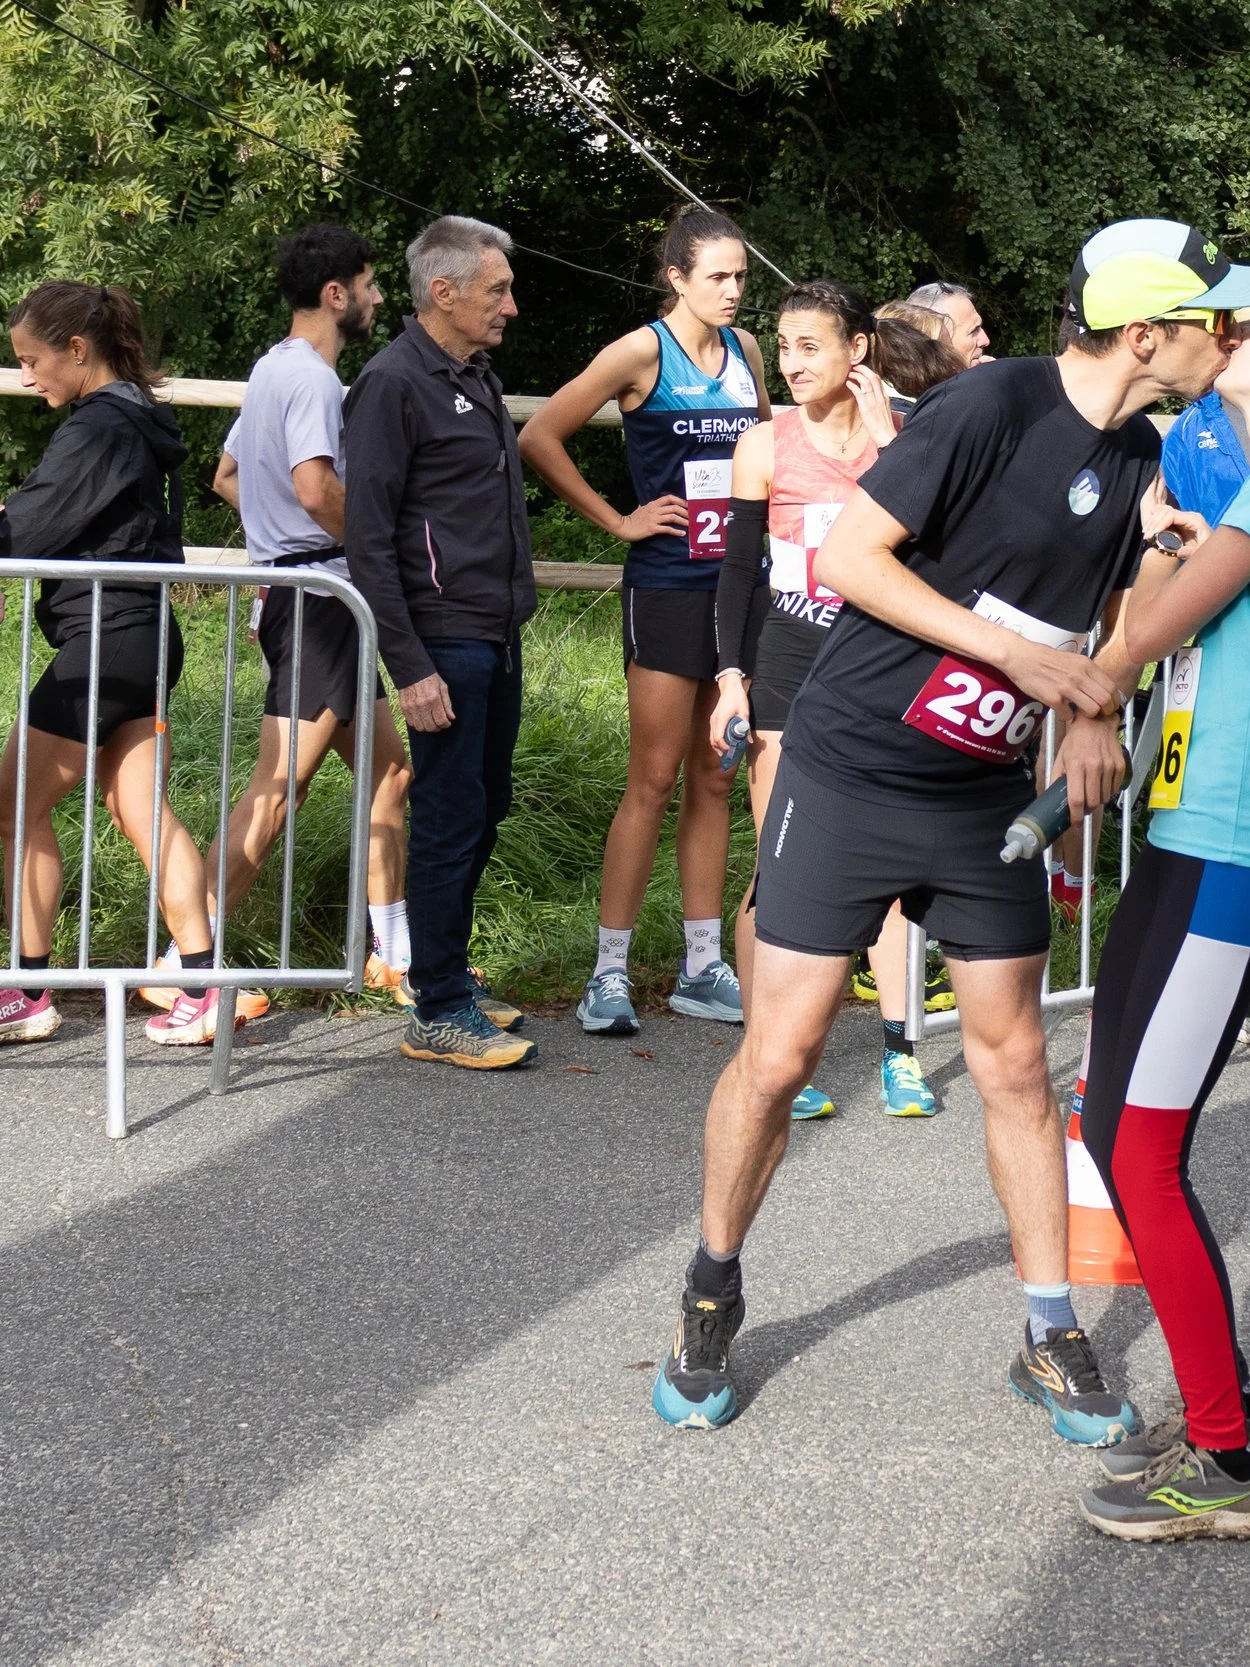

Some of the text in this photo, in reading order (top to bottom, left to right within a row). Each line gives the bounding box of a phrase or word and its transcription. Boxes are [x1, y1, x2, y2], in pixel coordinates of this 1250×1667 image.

[672, 416, 759, 435] CLERMON
[776, 592, 840, 629] NIKE
[925, 671, 1044, 745] 296
[774, 797, 795, 858] SALOMON
